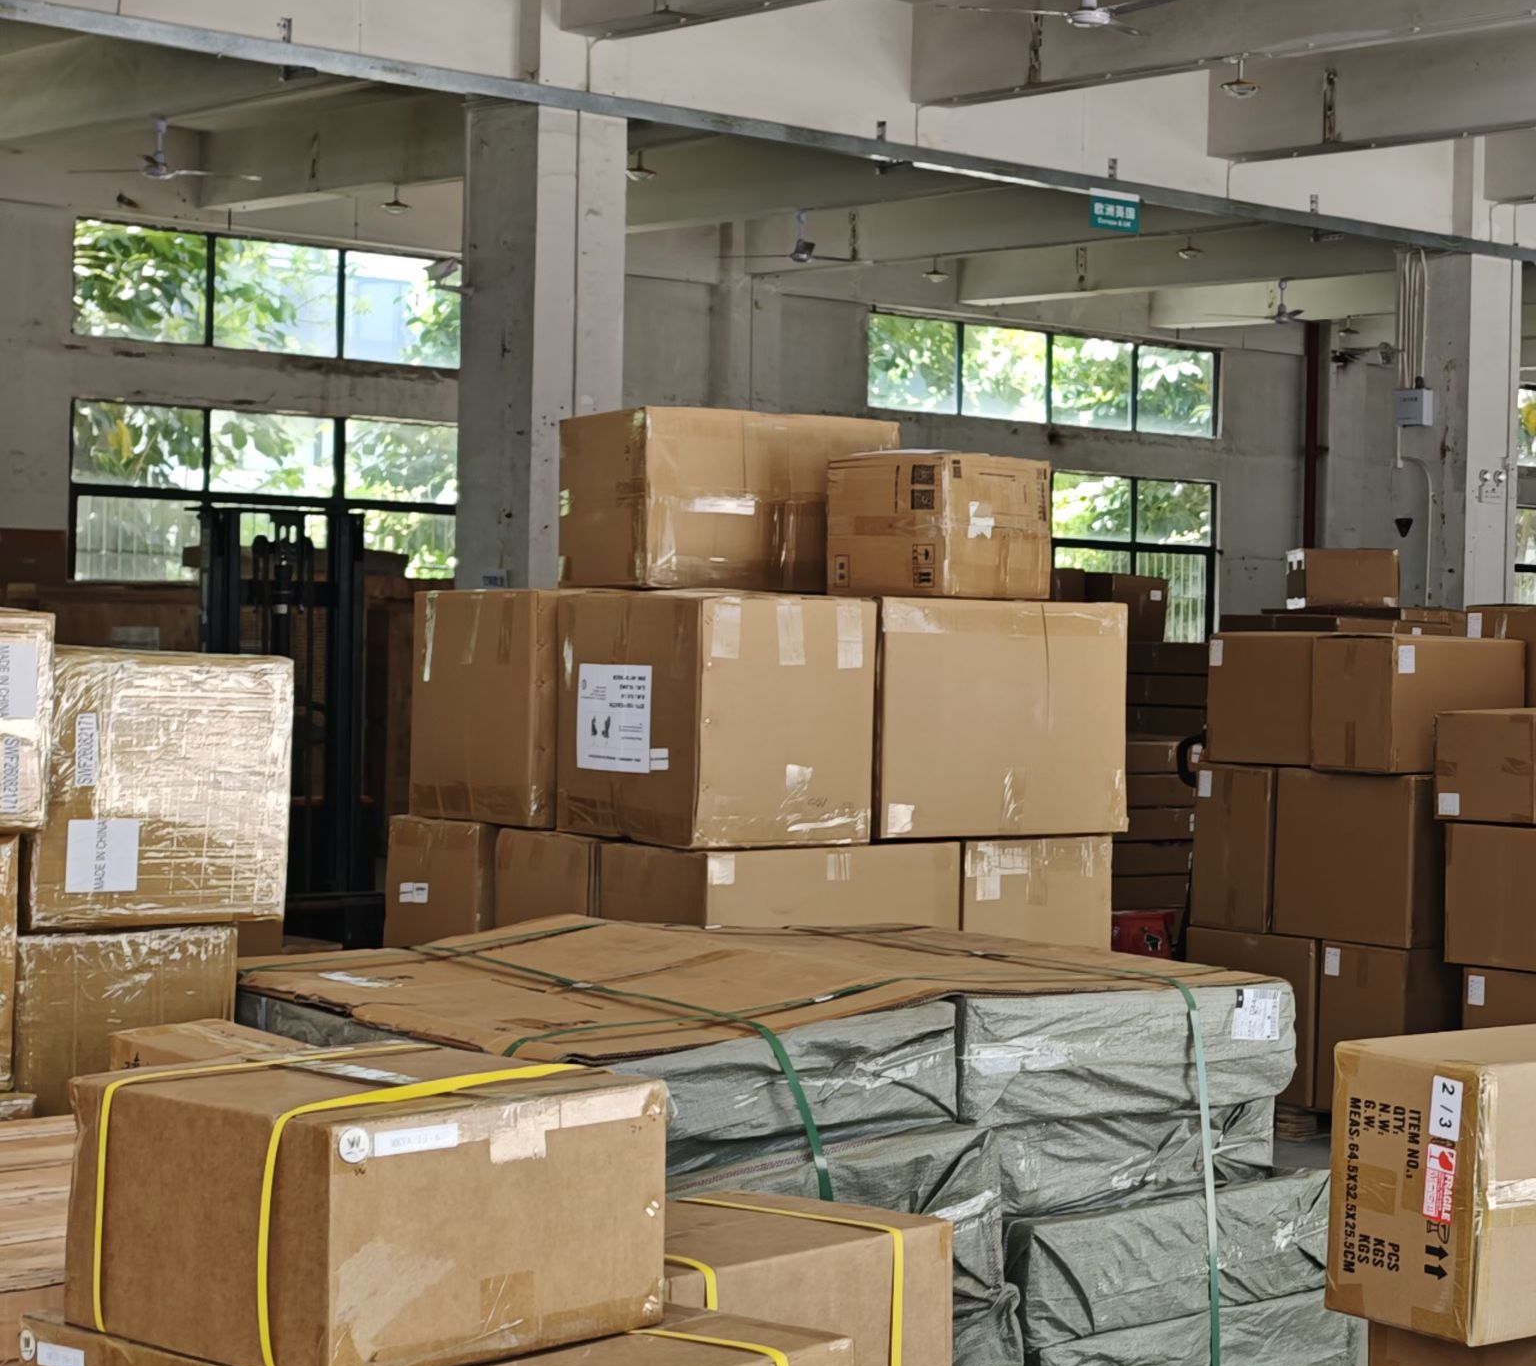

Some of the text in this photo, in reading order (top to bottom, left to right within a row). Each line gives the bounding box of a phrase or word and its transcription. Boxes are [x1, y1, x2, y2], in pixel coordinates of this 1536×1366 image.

[93, 820, 108, 890] MADE IN CHINA
[1407, 1109, 1421, 1146] ITEM
[1442, 1174, 1454, 1221] FRAGILE
[1358, 1233, 1371, 1264] KGS
[1372, 1237, 1386, 1267] KGS
[1387, 1242, 1400, 1272] PCS
